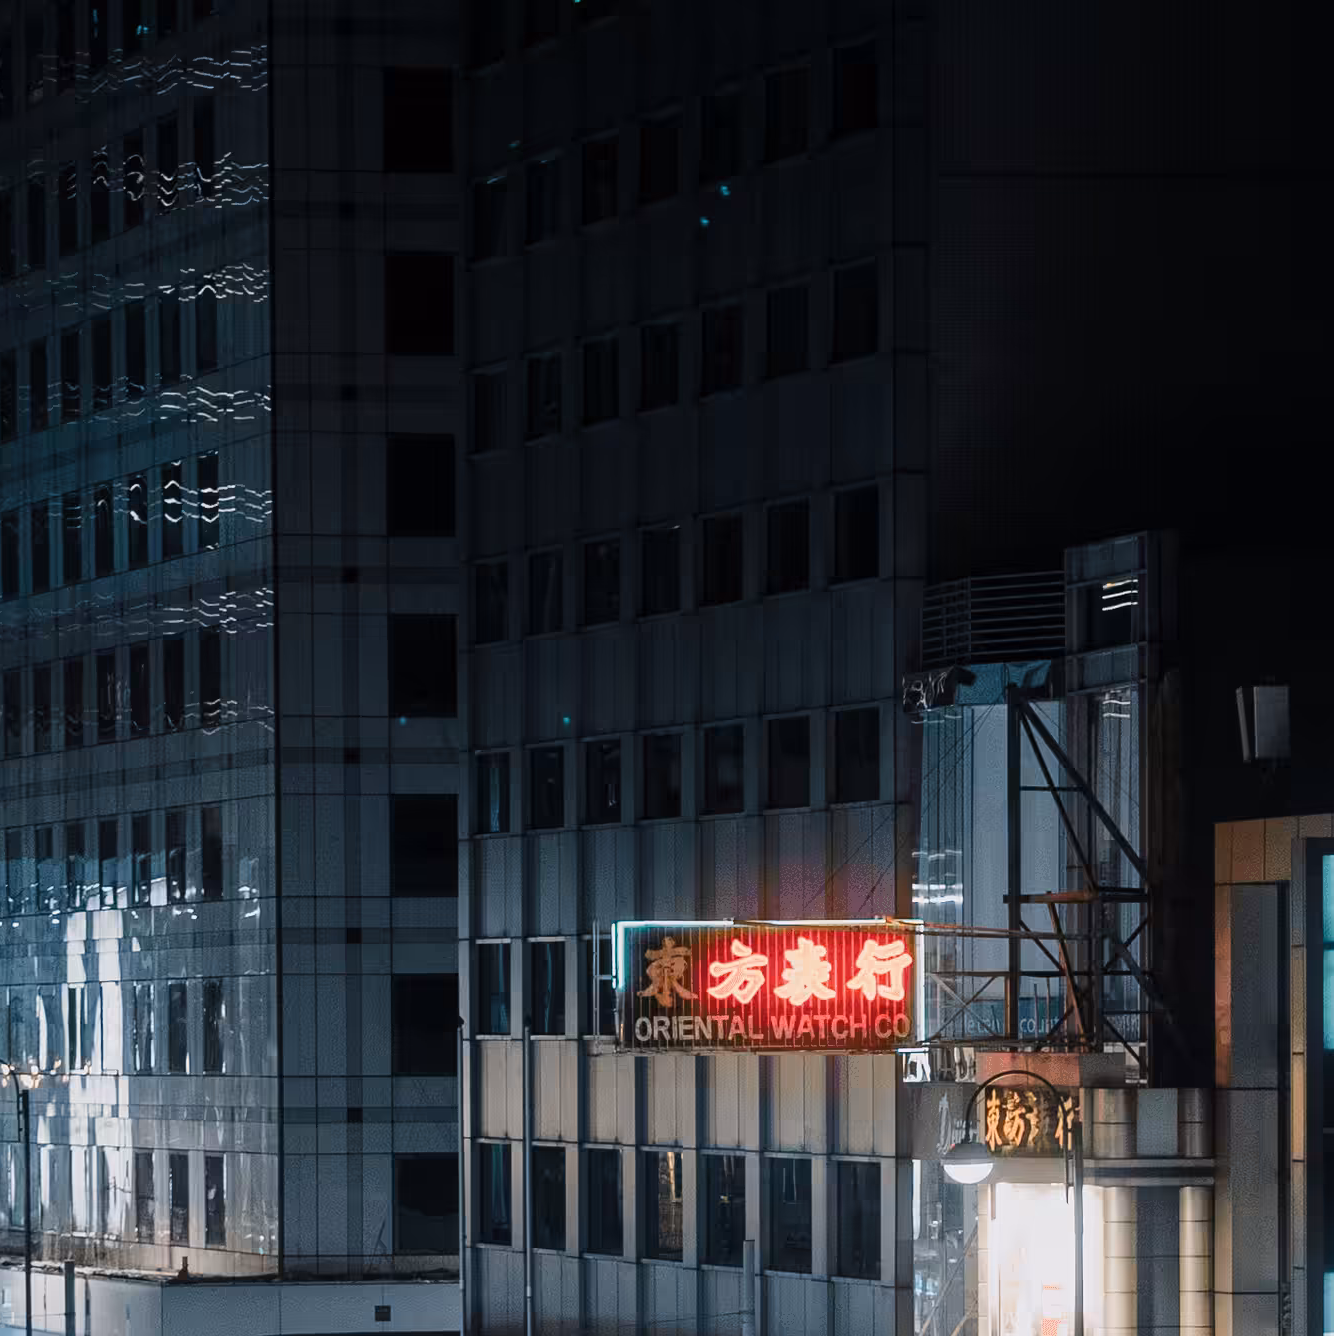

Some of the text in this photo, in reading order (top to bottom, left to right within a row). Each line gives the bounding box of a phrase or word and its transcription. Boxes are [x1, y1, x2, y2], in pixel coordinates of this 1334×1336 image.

[635, 1014, 910, 1042] ORIENTAL WATCH CO
